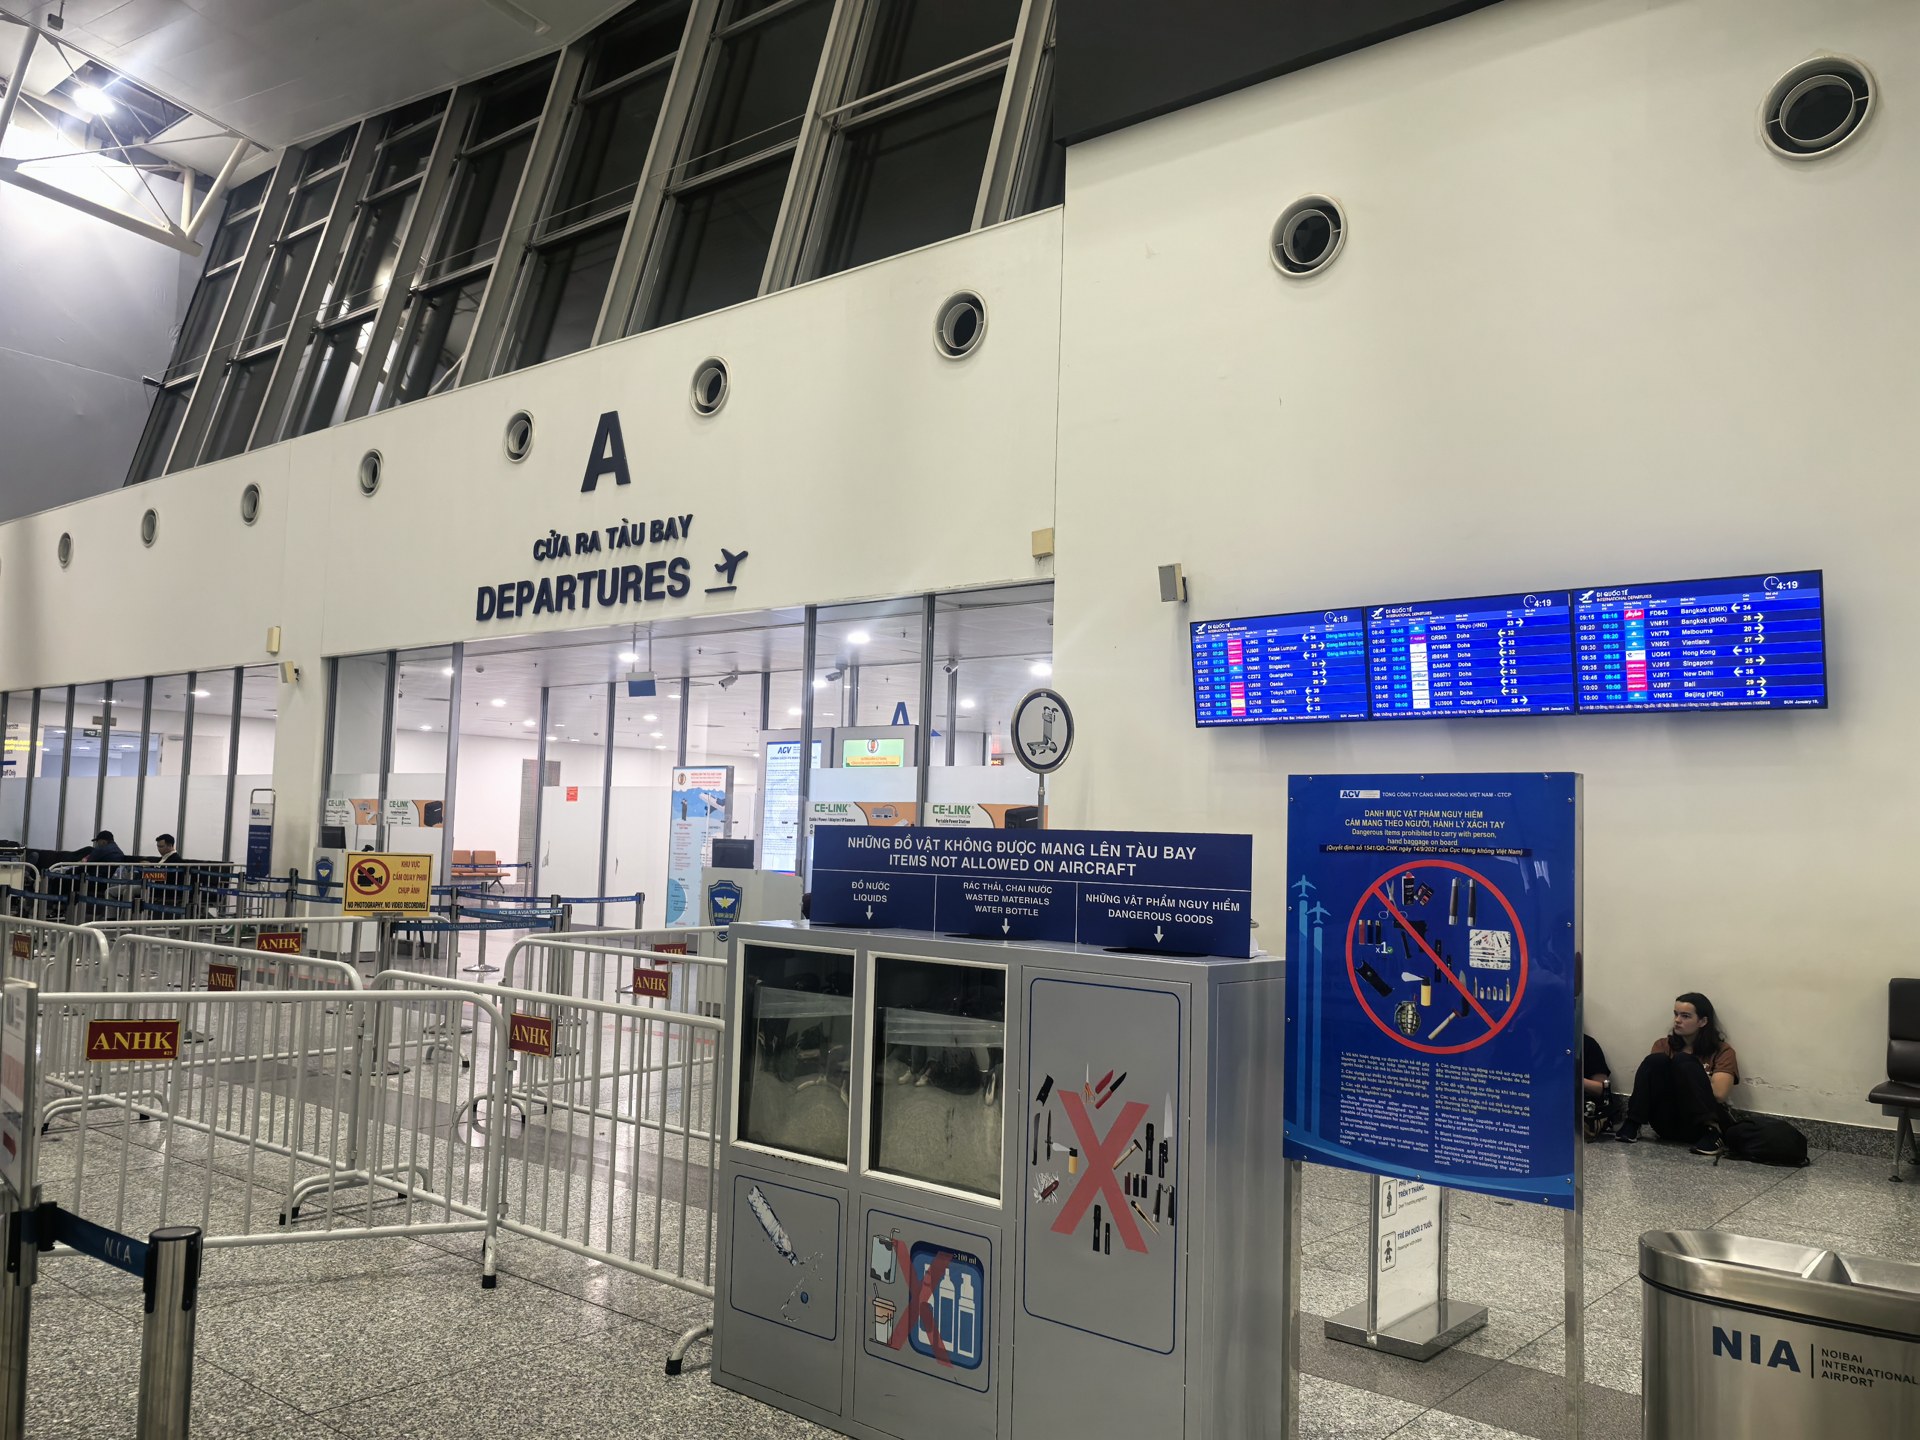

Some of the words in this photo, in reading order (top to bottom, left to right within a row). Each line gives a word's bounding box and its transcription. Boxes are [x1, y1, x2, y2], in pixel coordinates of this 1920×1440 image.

[580, 410, 631, 492] A
[533, 529, 572, 561] CỬA
[575, 530, 601, 554] RA
[606, 518, 645, 550] TÀU
[650, 514, 693, 543] BAY
[476, 557, 690, 621] DEPARTURES
[1777, 581, 1798, 589] 4:19
[1534, 599, 1552, 607] 4:19
[1333, 615, 1348, 623] 4:19
[777, 746, 792, 754] ACV
[814, 804, 848, 812] CE-LINK
[932, 804, 970, 815] CE-LINK
[1385, 810, 1402, 818] MỤC
[1433, 819, 1454, 828] HÀNH
[1455, 819, 1465, 828] LÝ
[1466, 819, 1488, 828] XÁCH
[1352, 828, 1383, 836] Dangerous
[847, 835, 891, 850] NHỮNG
[894, 834, 912, 850] ĐỒ
[916, 836, 940, 853] VẬT
[944, 838, 992, 853] KHÔNG
[996, 840, 1036, 857] ĐƯỢC
[1041, 842, 1085, 857] MANG
[1090, 841, 1121, 858] LÊN
[1126, 842, 1158, 859] TÀU
[1163, 846, 1197, 860] BAY
[1404, 838, 1429, 846] baggage
[889, 854, 927, 866] ITEMS
[931, 856, 958, 868] NOT
[961, 857, 1029, 871] ALLOWED
[1034, 860, 1054, 872] ON
[1058, 861, 1137, 876] AIRCRAFT
[392, 873, 403, 881] CẤM
[866, 881, 890, 891] NƯỚC
[963, 881, 980, 890] RÁC
[982, 882, 1003, 892] THẢI,
[1005, 884, 1026, 892] CHAI
[1028, 883, 1053, 894] NƯỚC
[853, 894, 888, 903] LIQUIDS
[965, 893, 999, 902] WASTED
[1002, 895, 1050, 906] MATERIALS
[1085, 892, 1121, 904] NHỮNG
[1123, 894, 1143, 906] VẬT
[1146, 893, 1176, 908] PHẨM
[1178, 899, 1209, 910] NGUY
[1212, 898, 1240, 912] HIỂM
[974, 905, 1003, 914] WATER
[1005, 906, 1039, 917] BOTTLE
[1108, 909, 1172, 922] DANGEROUS
[1175, 914, 1213, 924] GOODS
[259, 938, 299, 950] ANHK
[1376, 941, 1388, 954] x1
[209, 972, 235, 988] ANHK
[634, 976, 667, 992] ANHK
[92, 1032, 173, 1050] ANHK
[512, 1024, 549, 1047] ANHK
[1712, 1326, 1800, 1373] NIA
[1821, 1348, 1863, 1364] NOIBAI
[1821, 1359, 1919, 1385] INTERNATIONAL
[1821, 1370, 1874, 1388] AIRPORT
